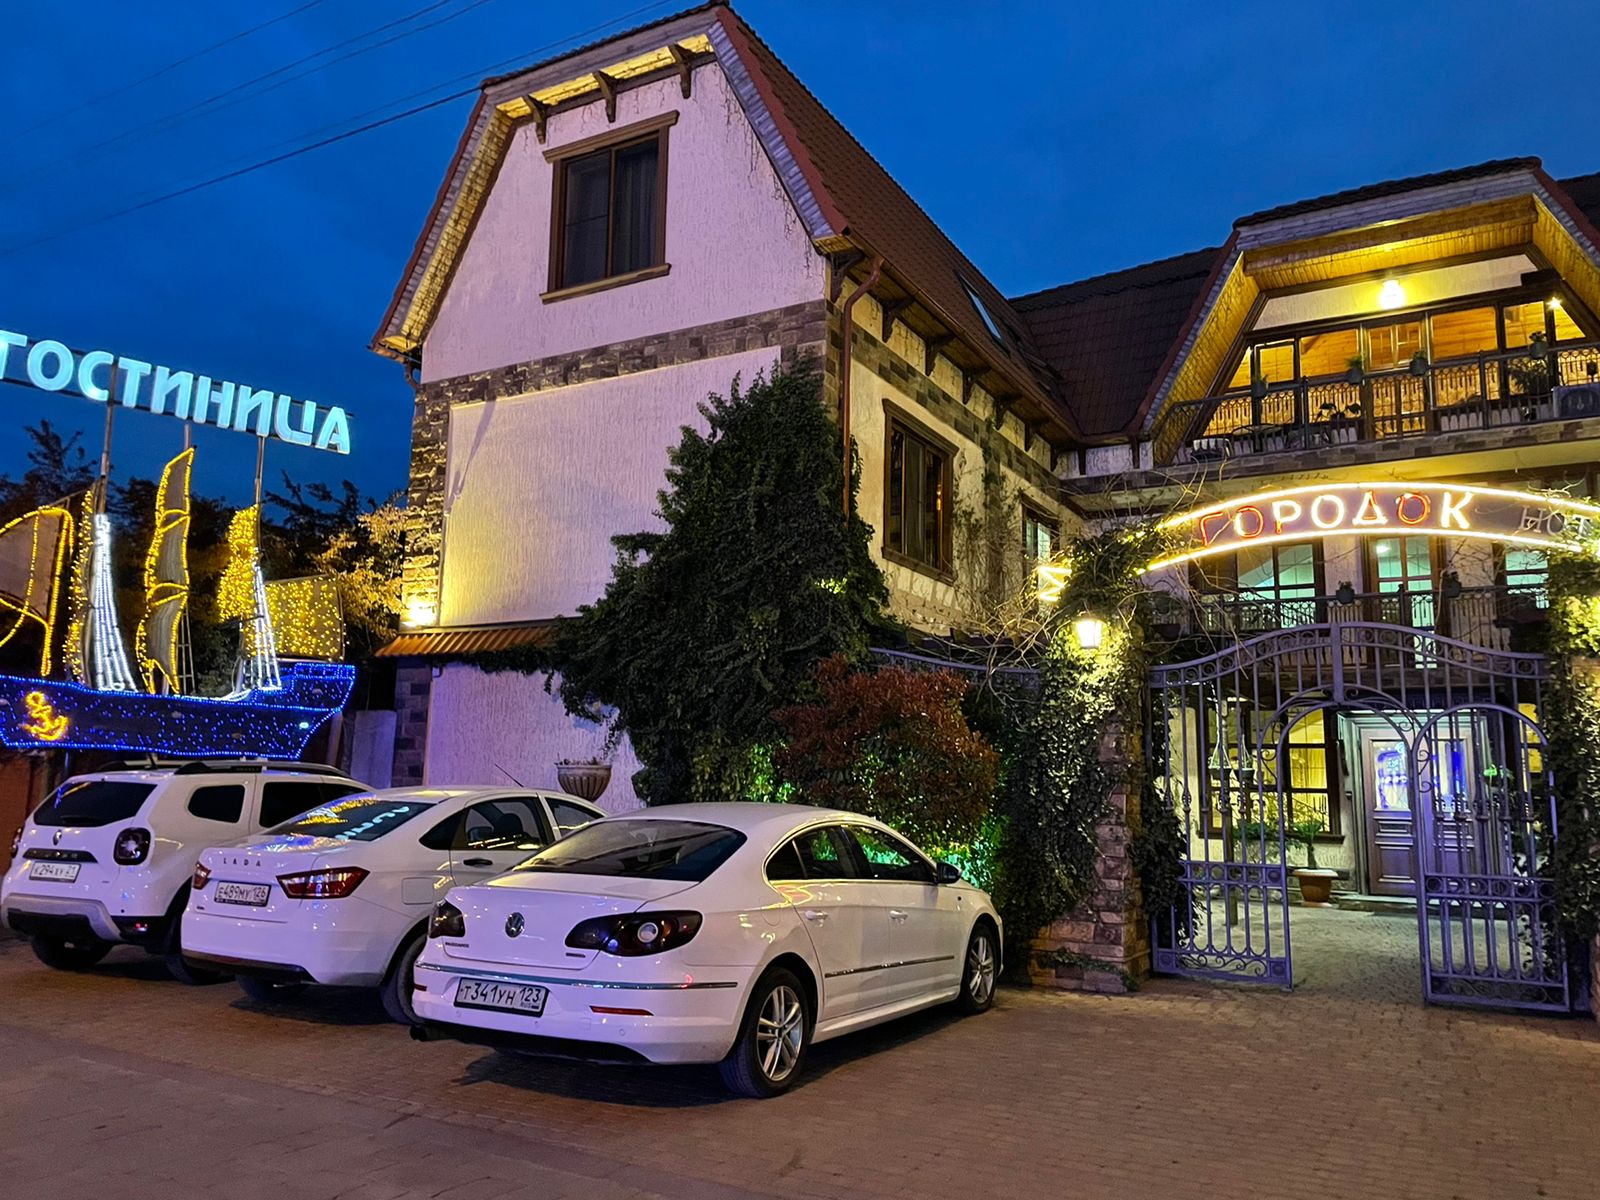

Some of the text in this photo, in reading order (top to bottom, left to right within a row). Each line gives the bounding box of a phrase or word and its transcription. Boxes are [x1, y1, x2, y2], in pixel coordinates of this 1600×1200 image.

[0, 329, 350, 455] ГОСТИНИЦА
[1199, 489, 1475, 546] ГОРОДОК
[223, 858, 261, 867] LADA
[520, 986, 541, 1003] 123
